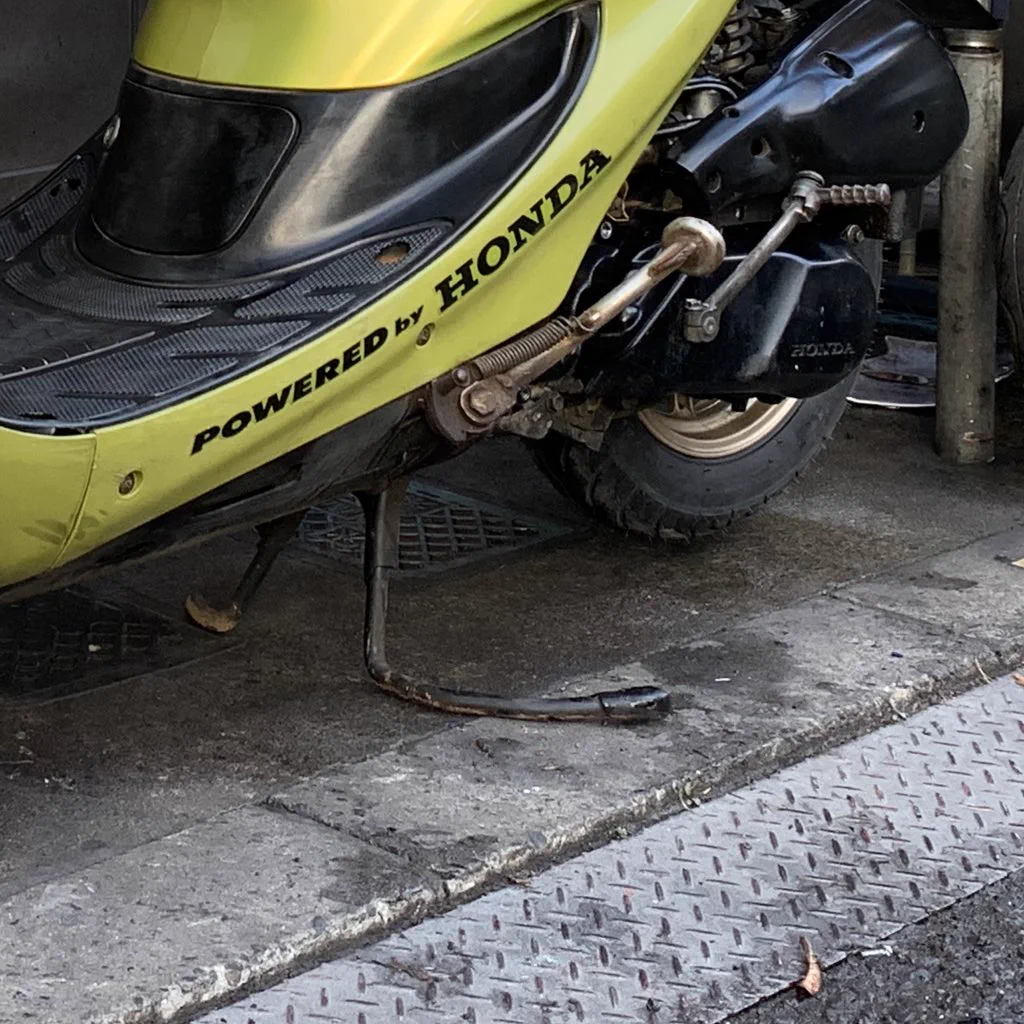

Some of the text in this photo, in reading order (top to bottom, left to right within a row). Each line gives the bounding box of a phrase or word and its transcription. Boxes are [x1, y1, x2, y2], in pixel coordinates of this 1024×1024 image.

[190, 149, 612, 456] POWERED by HONDA
[790, 341, 856, 358] HONDA
